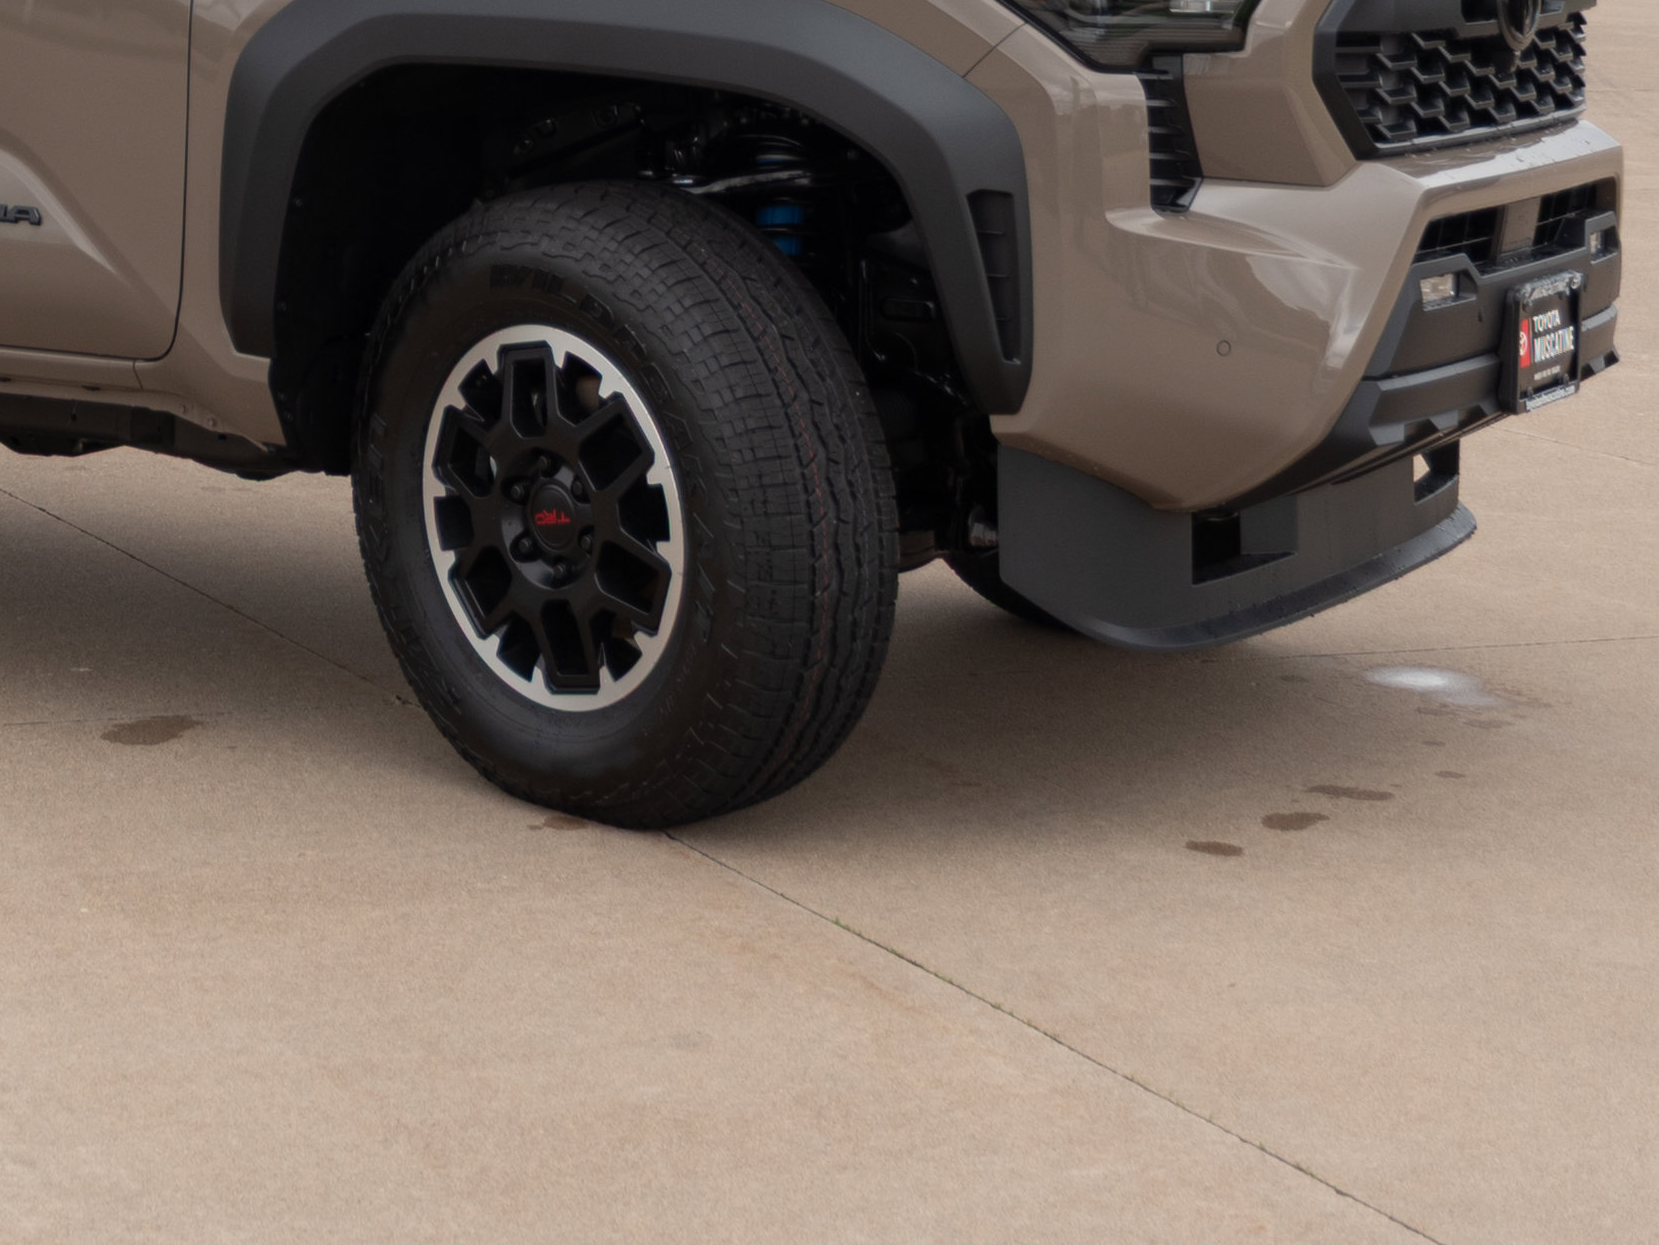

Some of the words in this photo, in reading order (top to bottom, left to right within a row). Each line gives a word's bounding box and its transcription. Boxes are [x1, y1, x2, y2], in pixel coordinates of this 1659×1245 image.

[1532, 309, 1560, 333] TOYOTA
[1533, 326, 1574, 363] MUSCATINE
[534, 509, 571, 526] TRD
